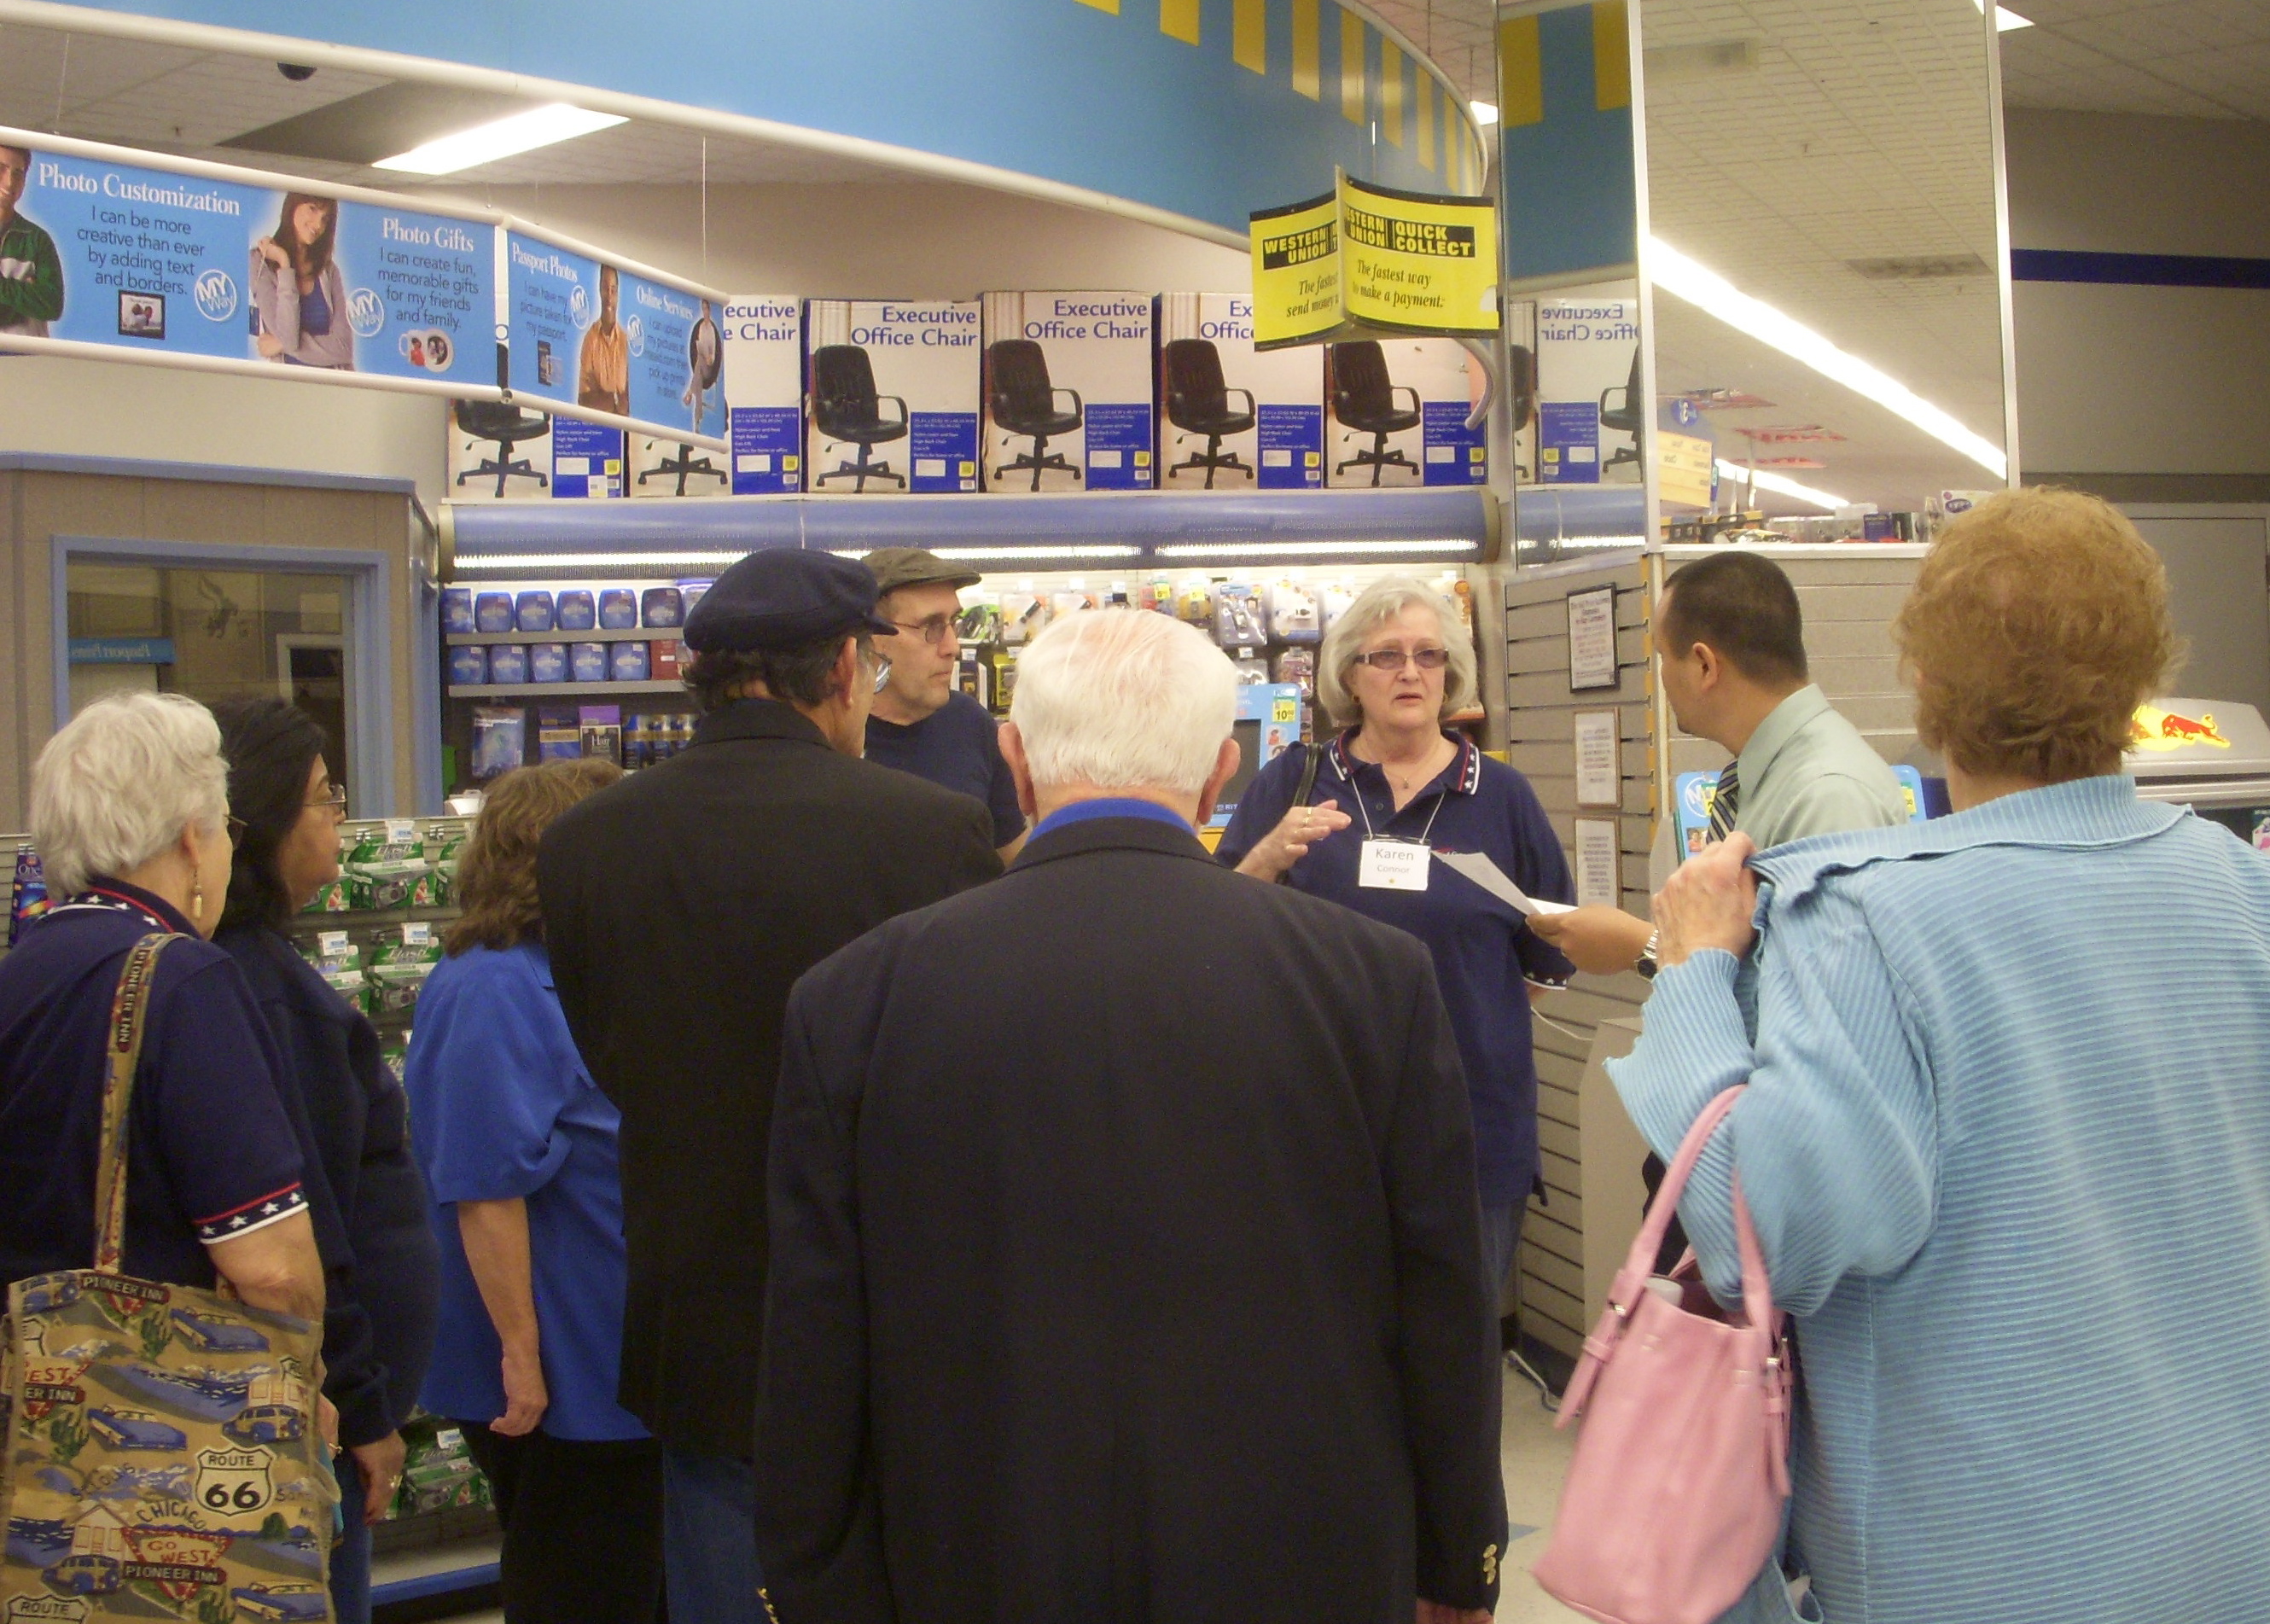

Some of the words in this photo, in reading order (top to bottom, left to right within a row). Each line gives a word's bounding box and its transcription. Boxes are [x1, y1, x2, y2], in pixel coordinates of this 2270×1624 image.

[39, 163, 98, 194] Photo
[103, 173, 240, 216] Customization
[92, 205, 96, 220] I
[100, 211, 126, 225] can
[131, 210, 150, 229] be
[154, 219, 192, 235] more
[383, 217, 430, 245] Photo
[434, 226, 474, 252] Gifts
[1264, 228, 1326, 254] WESTERN
[1350, 224, 1385, 247] UNION
[1395, 221, 1448, 241] QUICK
[77, 228, 134, 247] creative
[138, 233, 170, 252] than
[173, 243, 206, 257] ever
[1288, 242, 1326, 264] UNION
[1395, 237, 1471, 256] COLLECT
[88, 246, 107, 268] by
[111, 252, 163, 276] adding
[167, 260, 195, 276] text
[380, 247, 384, 261] I
[387, 252, 409, 265] can
[412, 255, 450, 271] create
[454, 257, 476, 277] fun,
[513, 242, 548, 274] Passport
[550, 254, 578, 282] Photos
[95, 270, 124, 287] and
[128, 272, 188, 295] borders.
[378, 269, 450, 289] memorable
[453, 278, 479, 295] gifts
[1358, 259, 1371, 276] The
[1371, 263, 1405, 282] fastest
[1408, 272, 1432, 289] way
[196, 274, 227, 302] MY
[1299, 279, 1315, 295] The
[1360, 284, 1382, 300] make
[1384, 291, 1390, 302] a
[349, 292, 376, 318] MY
[387, 285, 404, 301] for
[407, 293, 427, 309] my
[429, 291, 471, 311] friends
[637, 285, 662, 310] Online
[664, 294, 692, 319] Services
[1054, 298, 1148, 317] Executive
[1286, 299, 1310, 317] send
[396, 308, 420, 323] and
[423, 309, 462, 332] family.
[882, 305, 977, 325] Executive
[740, 323, 796, 341] Chair
[850, 327, 915, 346] Office
[921, 326, 979, 347] Chair
[1024, 321, 1087, 340] Office
[1092, 321, 1150, 340] Chair
[1376, 848, 1414, 861] Karen
[1377, 864, 1410, 874] Connor
[119, 1018, 131, 1043] INN
[142, 1288, 164, 1300] INN
[25, 1367, 70, 1382] EST
[49, 1388, 76, 1401] INN
[208, 1454, 254, 1466] ROUTE
[205, 1481, 260, 1508] 66
[148, 1540, 178, 1551] GO
[160, 1550, 211, 1563] WEST
[126, 1565, 190, 1580] PIONEER
[194, 1569, 218, 1582] INN
[20, 1601, 70, 1615] ROUTE
